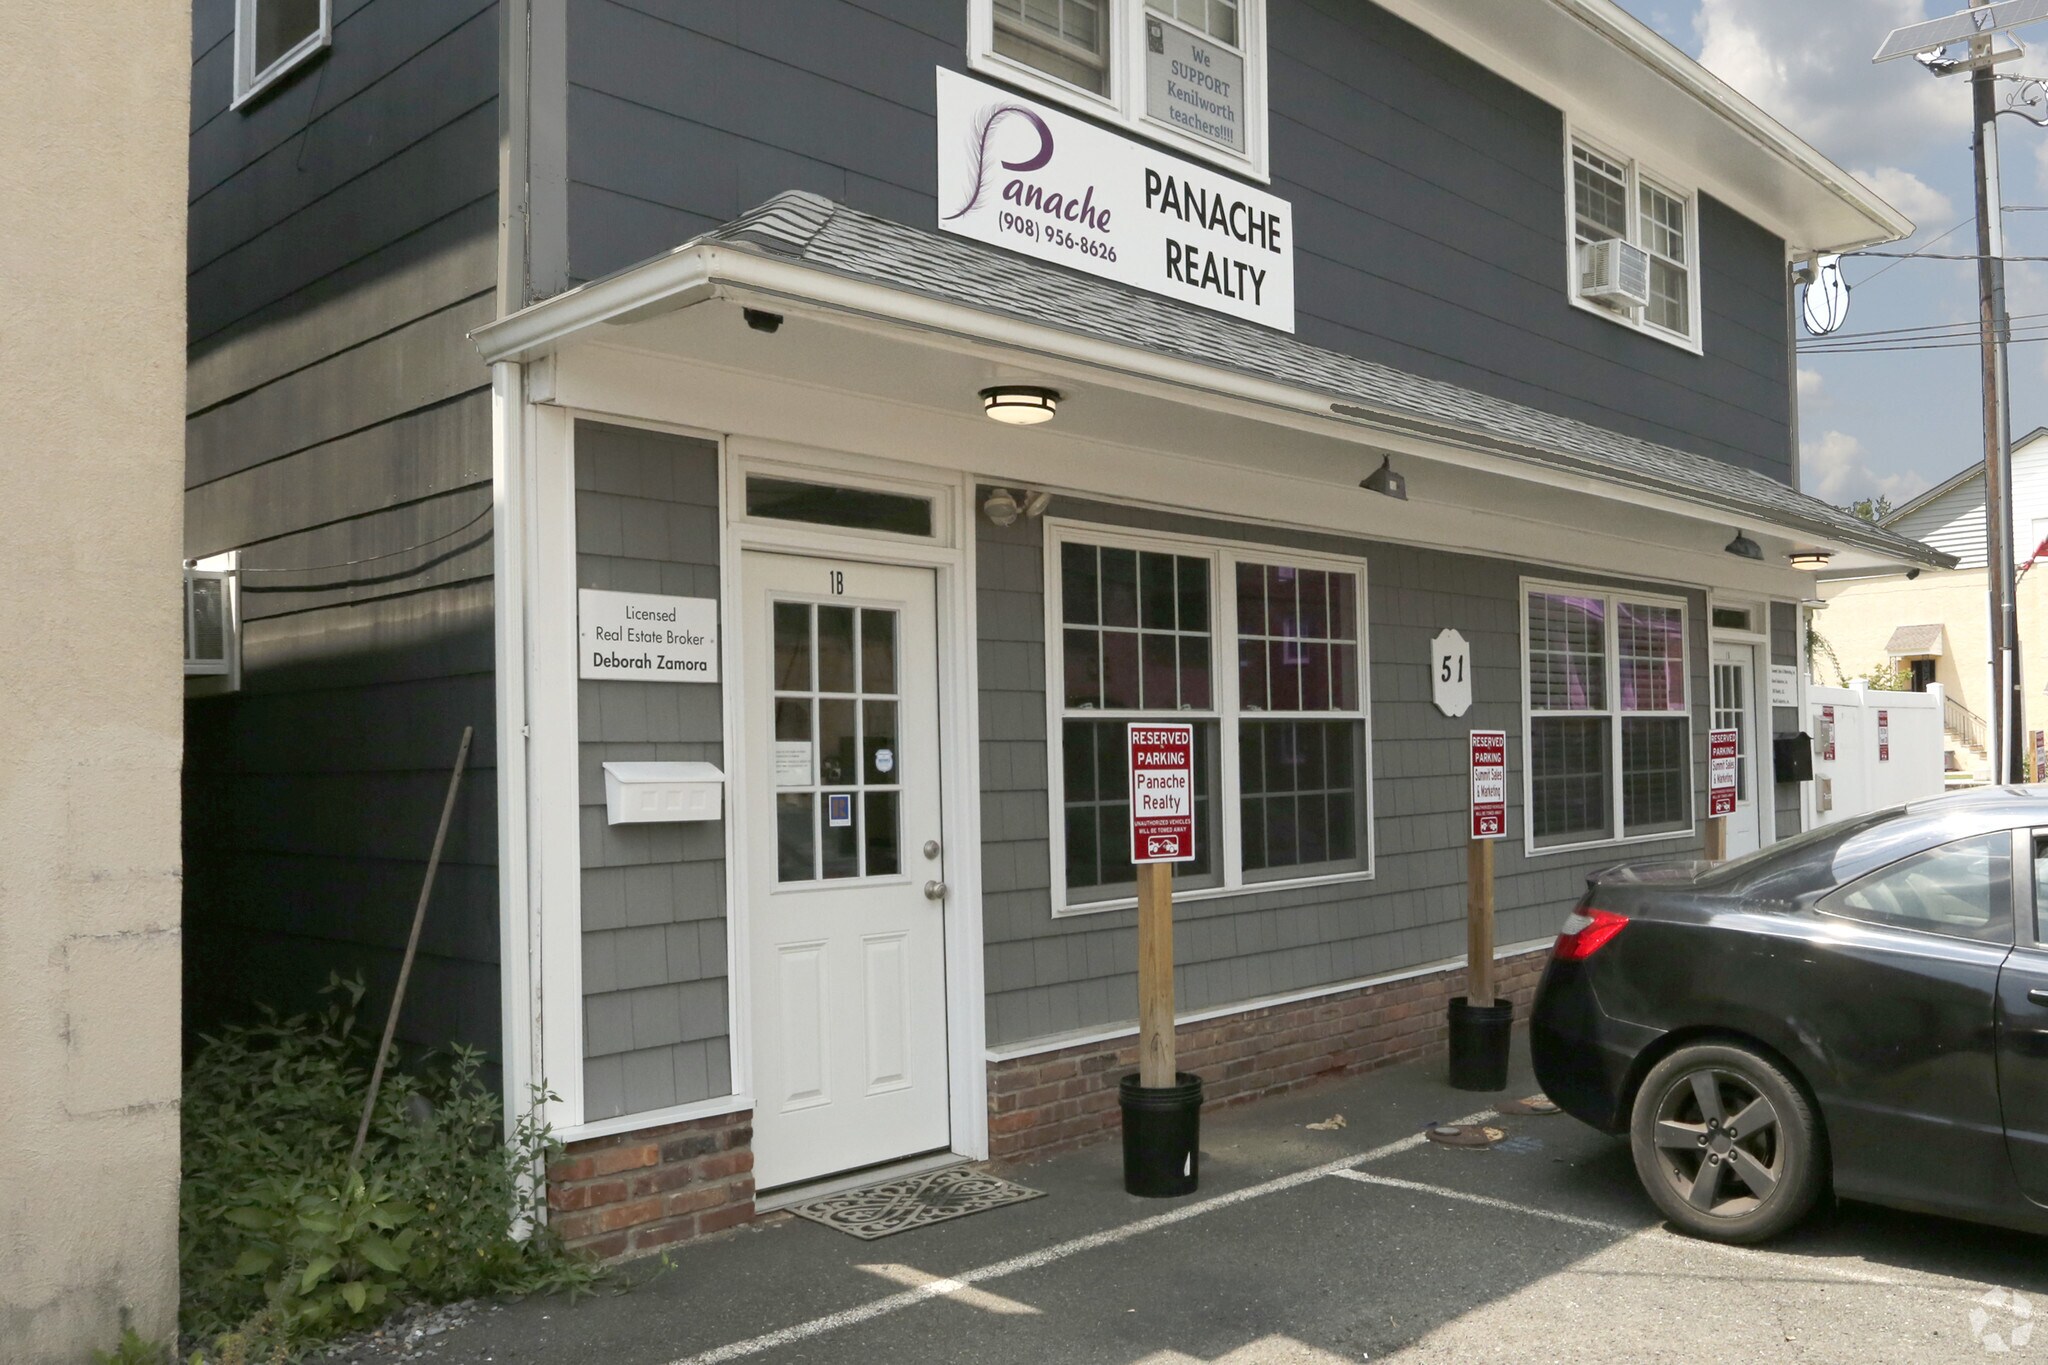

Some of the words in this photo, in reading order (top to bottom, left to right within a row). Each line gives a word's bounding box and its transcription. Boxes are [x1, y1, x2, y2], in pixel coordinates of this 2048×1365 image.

[1191, 45, 1211, 68] We
[1171, 60, 1230, 98] SUPPORT
[1167, 80, 1235, 122] Kenilworth
[1169, 105, 1234, 143] teachers!!!!
[941, 102, 1111, 234] Panache
[1145, 167, 1281, 254] PANACHE
[998, 211, 1040, 243] (908)
[1044, 225, 1118, 263] 956-8626
[1165, 238, 1266, 306] REALTY
[829, 570, 844, 595] 1B
[625, 606, 677, 623] Licensed
[596, 626, 623, 642] Real
[627, 628, 663, 644] Estate
[666, 630, 705, 646] Broker
[592, 653, 652, 670] Deborah
[656, 655, 708, 672] Zamora
[1441, 655, 1464, 683] 51
[1132, 731, 1189, 745] RESERVED
[1472, 736, 1504, 747] RESERVED
[1711, 733, 1736, 743] RESERVED
[1137, 752, 1185, 765] PARKING
[1475, 753, 1502, 763] PARKING
[1712, 746, 1734, 756] PARKING
[1137, 774, 1186, 789] Panache
[1475, 768, 1490, 781] Summit
[1491, 768, 1503, 781] Sales
[1481, 785, 1501, 800] Marketing
[1143, 795, 1181, 814] Realty
[1169, 818, 1191, 826] VEHICLES
